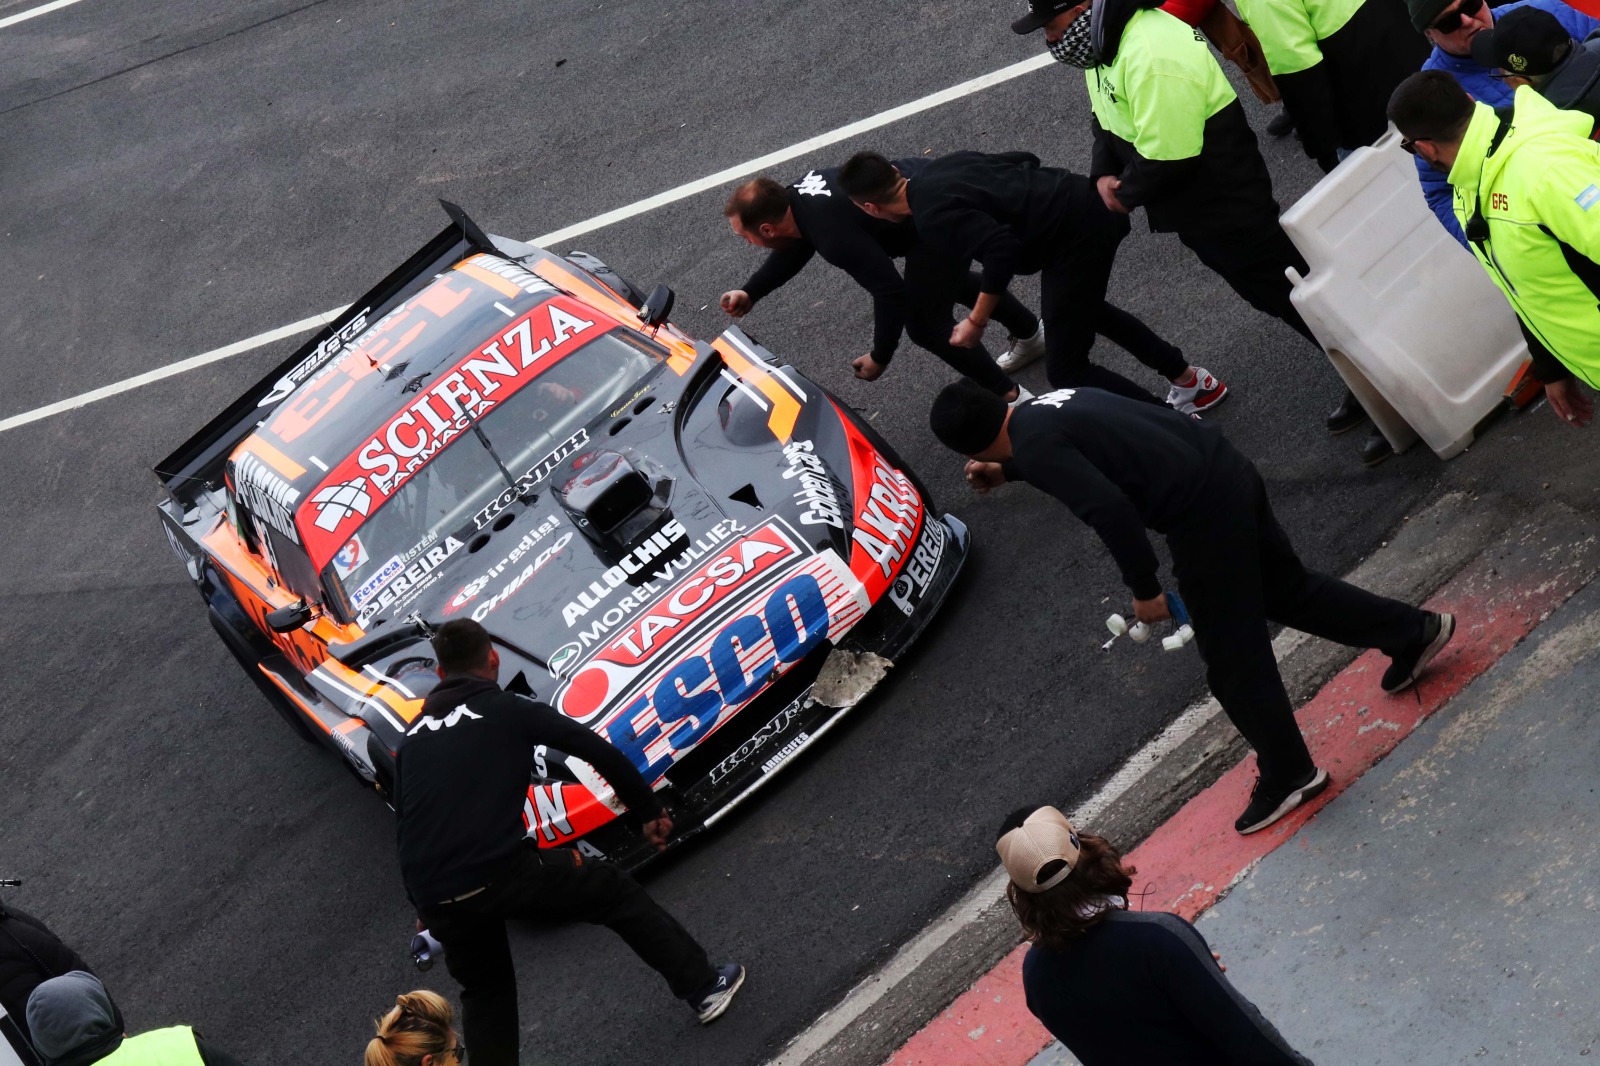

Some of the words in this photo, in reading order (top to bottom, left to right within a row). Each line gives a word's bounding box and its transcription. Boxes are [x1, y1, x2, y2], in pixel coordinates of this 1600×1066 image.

[1492, 193, 1508, 211] GPS
[357, 304, 595, 490] SCIENZA
[380, 399, 496, 496] FARMACIA
[352, 560, 400, 603] Ferrea
[356, 536, 464, 630] PEREIRA
[471, 532, 573, 623] CHIADO
[561, 519, 686, 627] ALLOCHIS
[578, 582, 662, 648] MOREL
[652, 519, 747, 581] VULLIEZ
[611, 540, 787, 659] TACSA
[605, 574, 830, 789] ESCO
[760, 732, 810, 774] ARRECIFES
